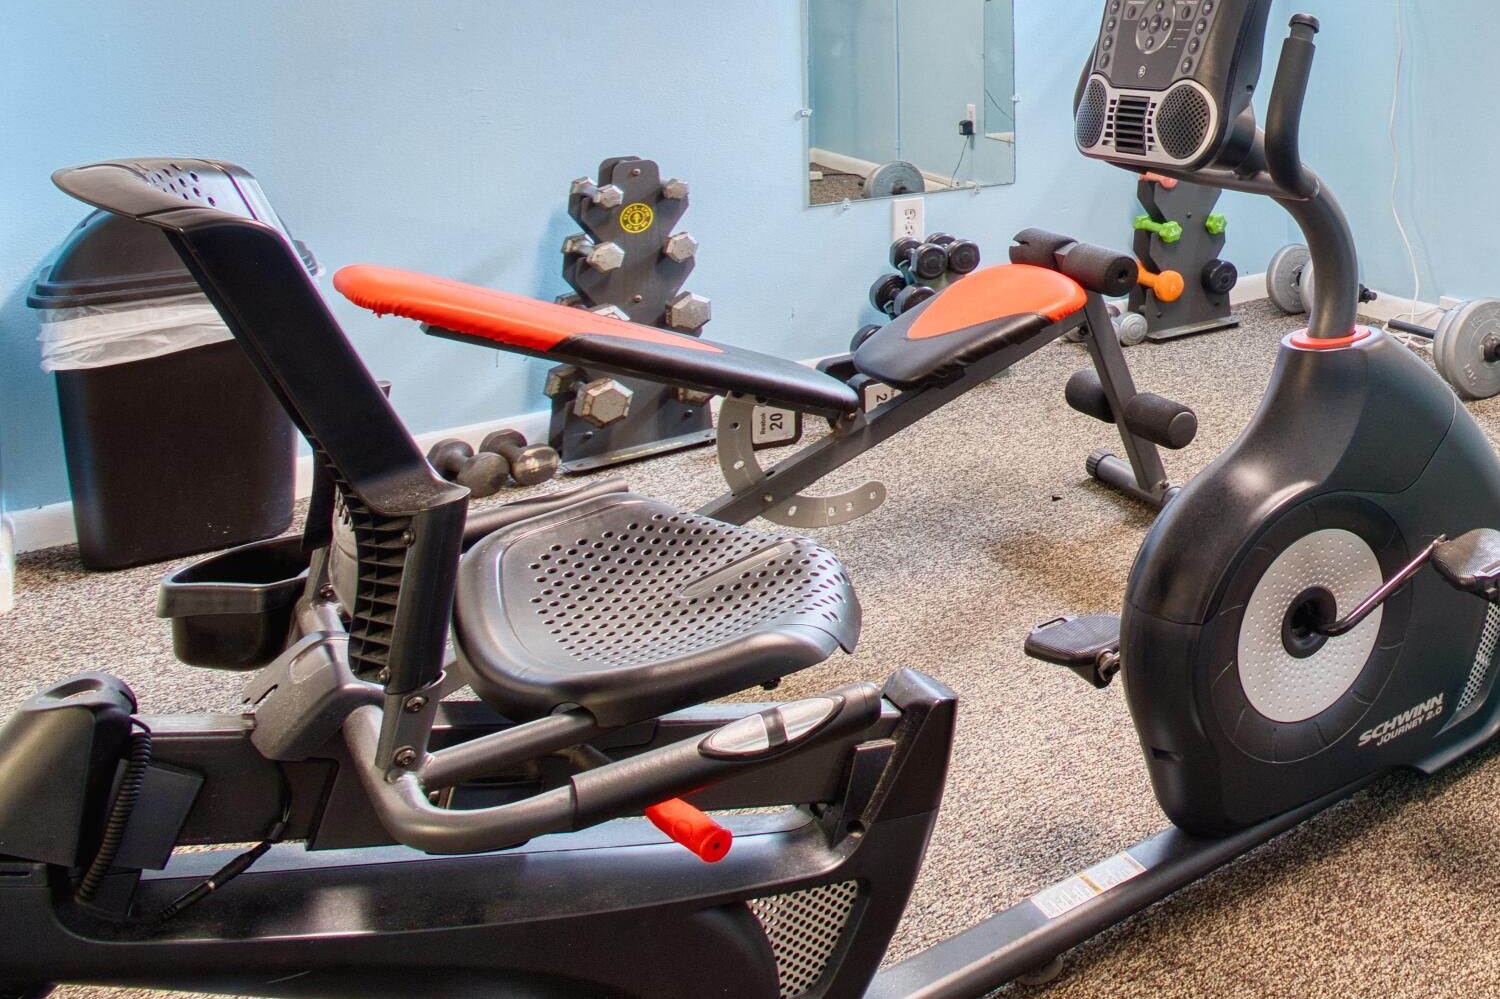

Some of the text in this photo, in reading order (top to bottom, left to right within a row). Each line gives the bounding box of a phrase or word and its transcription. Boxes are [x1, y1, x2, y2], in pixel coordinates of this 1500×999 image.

[770, 413, 783, 431] 20
[1358, 692, 1444, 747] SCHWINN
[1377, 706, 1443, 747] JOURNEY 2.0
